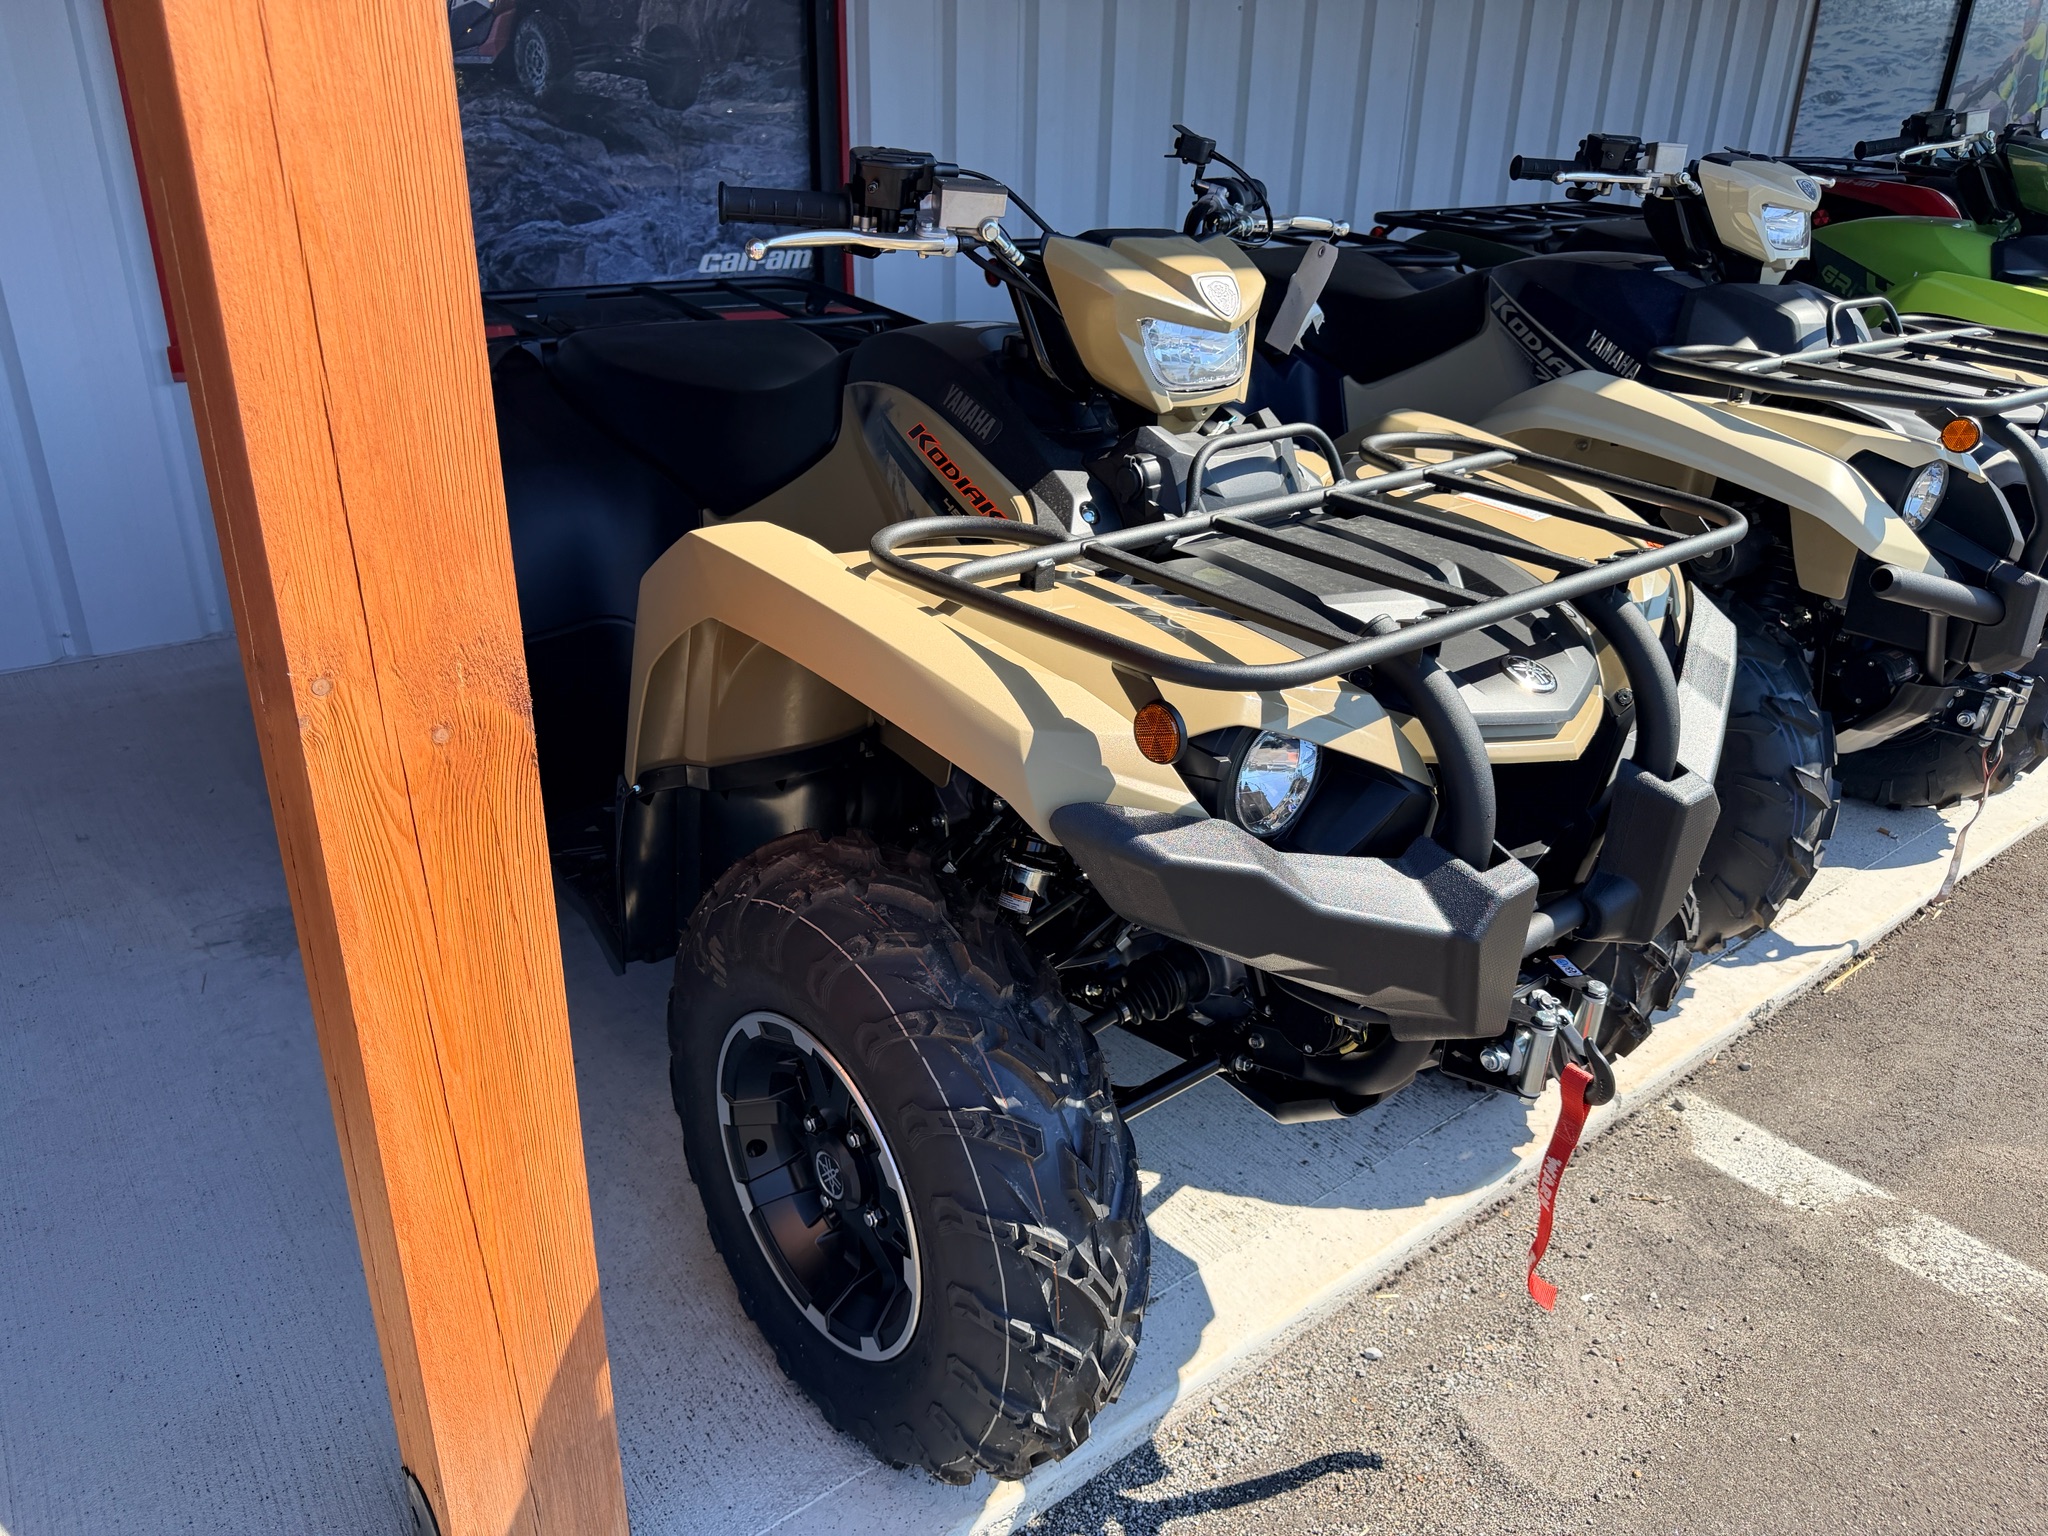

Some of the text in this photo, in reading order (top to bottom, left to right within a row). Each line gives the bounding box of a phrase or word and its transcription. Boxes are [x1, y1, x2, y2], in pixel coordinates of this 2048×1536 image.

[1490, 295, 1575, 376] KODIA
[1585, 329, 1641, 380] YAMAHA
[942, 384, 997, 440] YAMAHA
[1539, 1155, 1563, 1212] WARN
